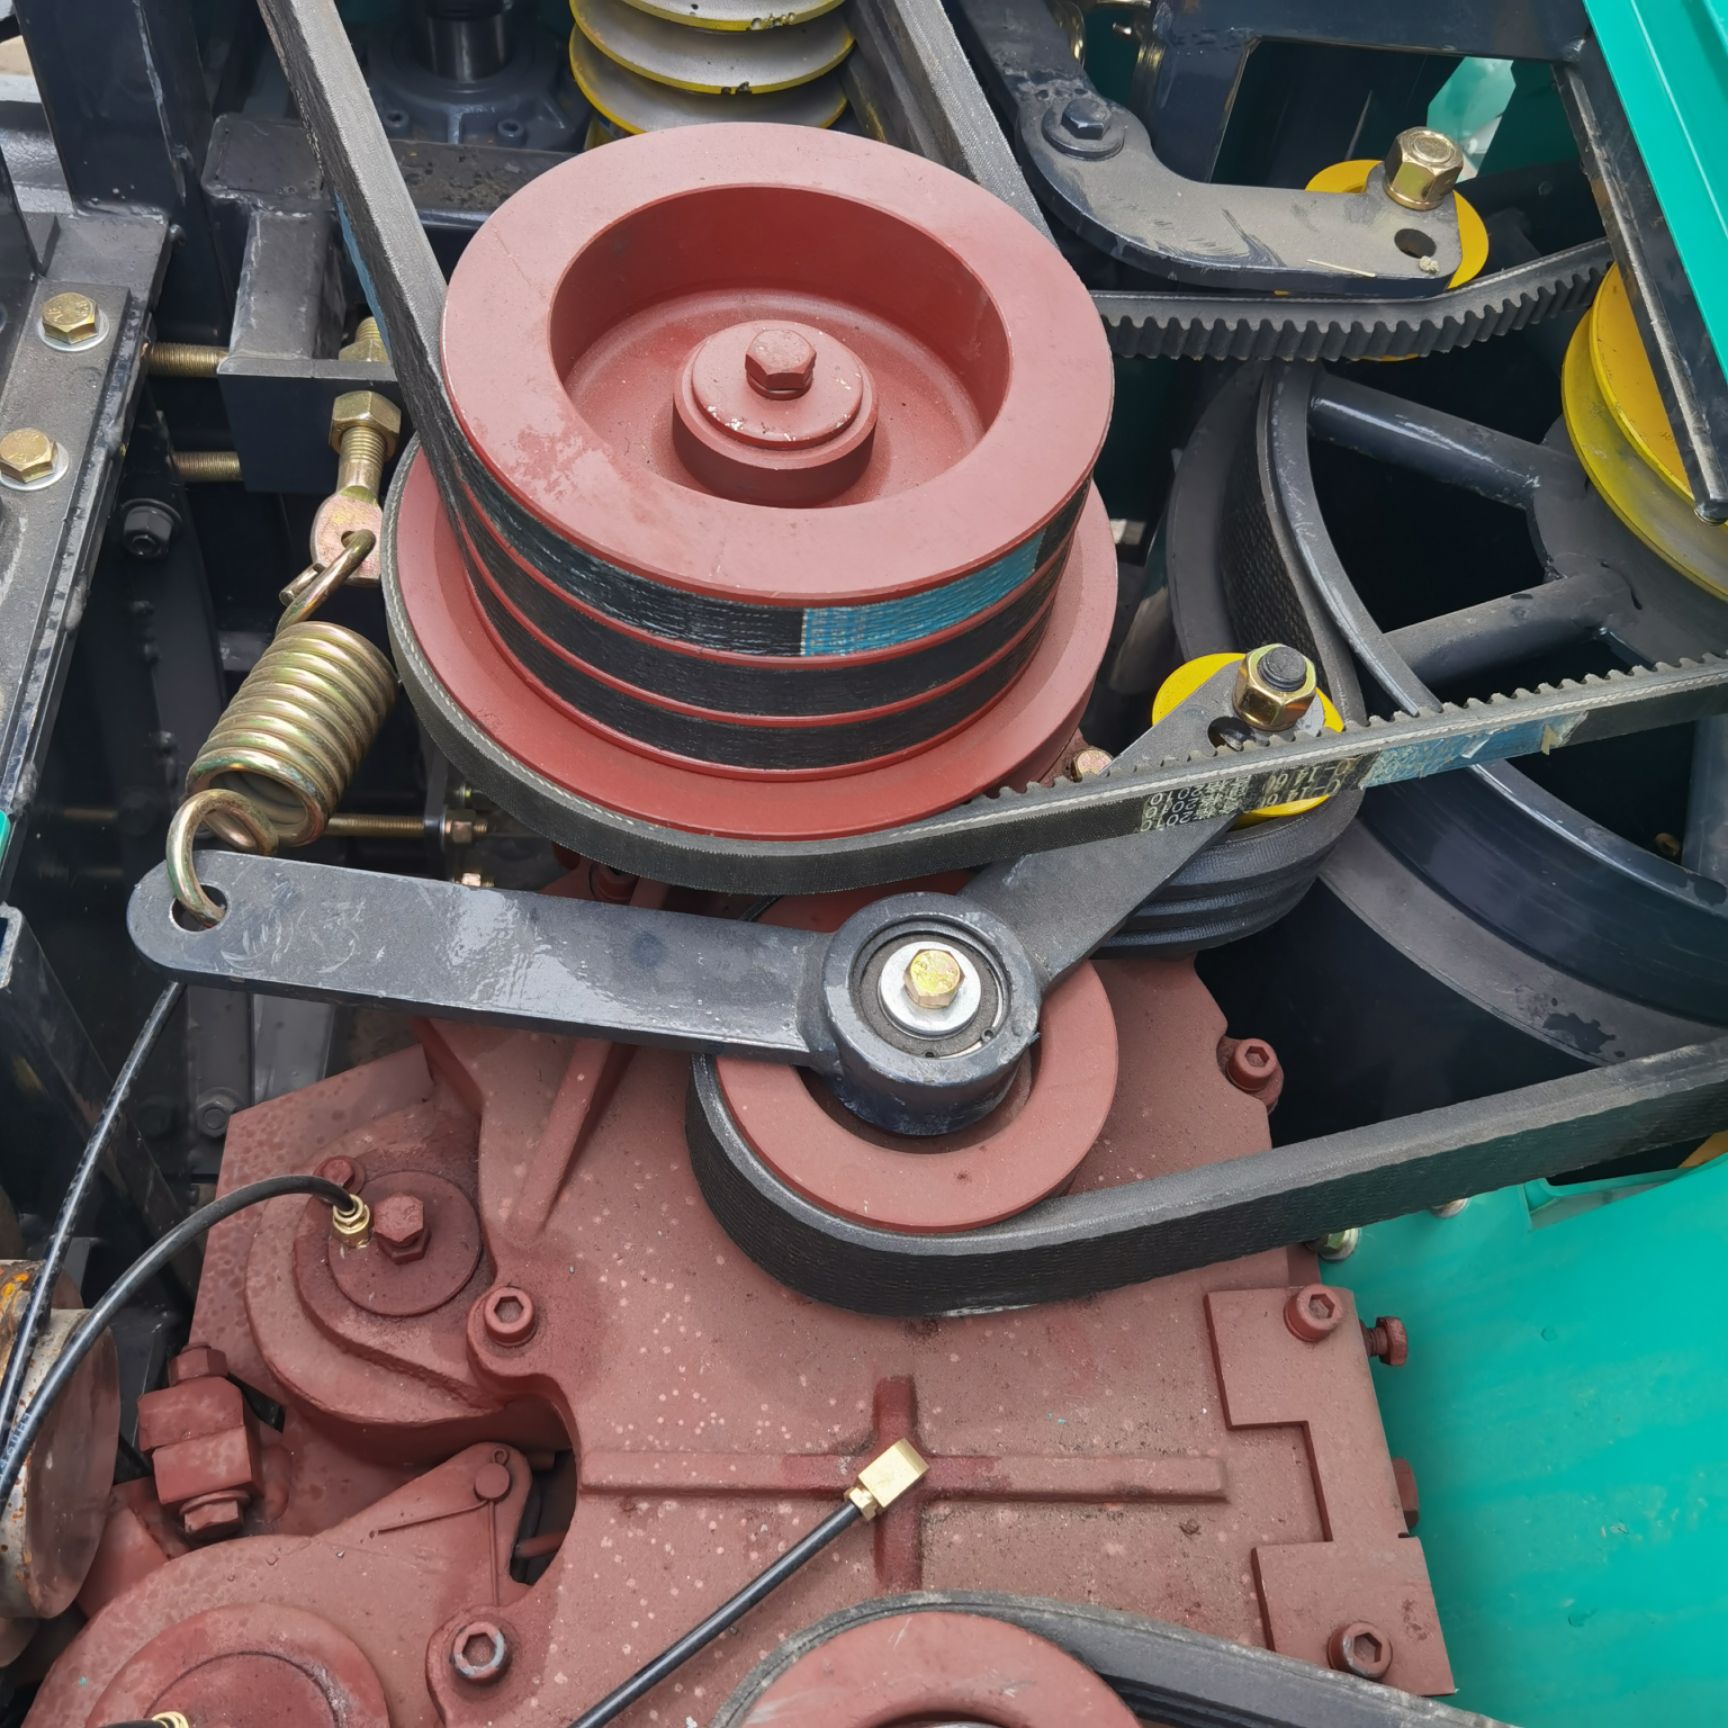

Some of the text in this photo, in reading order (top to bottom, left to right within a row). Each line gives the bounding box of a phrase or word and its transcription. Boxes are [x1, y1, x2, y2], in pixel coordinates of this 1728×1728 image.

[1150, 784, 1202, 806] 2010
[1145, 798, 1199, 819] 2010
[1140, 811, 1195, 832] 2010
